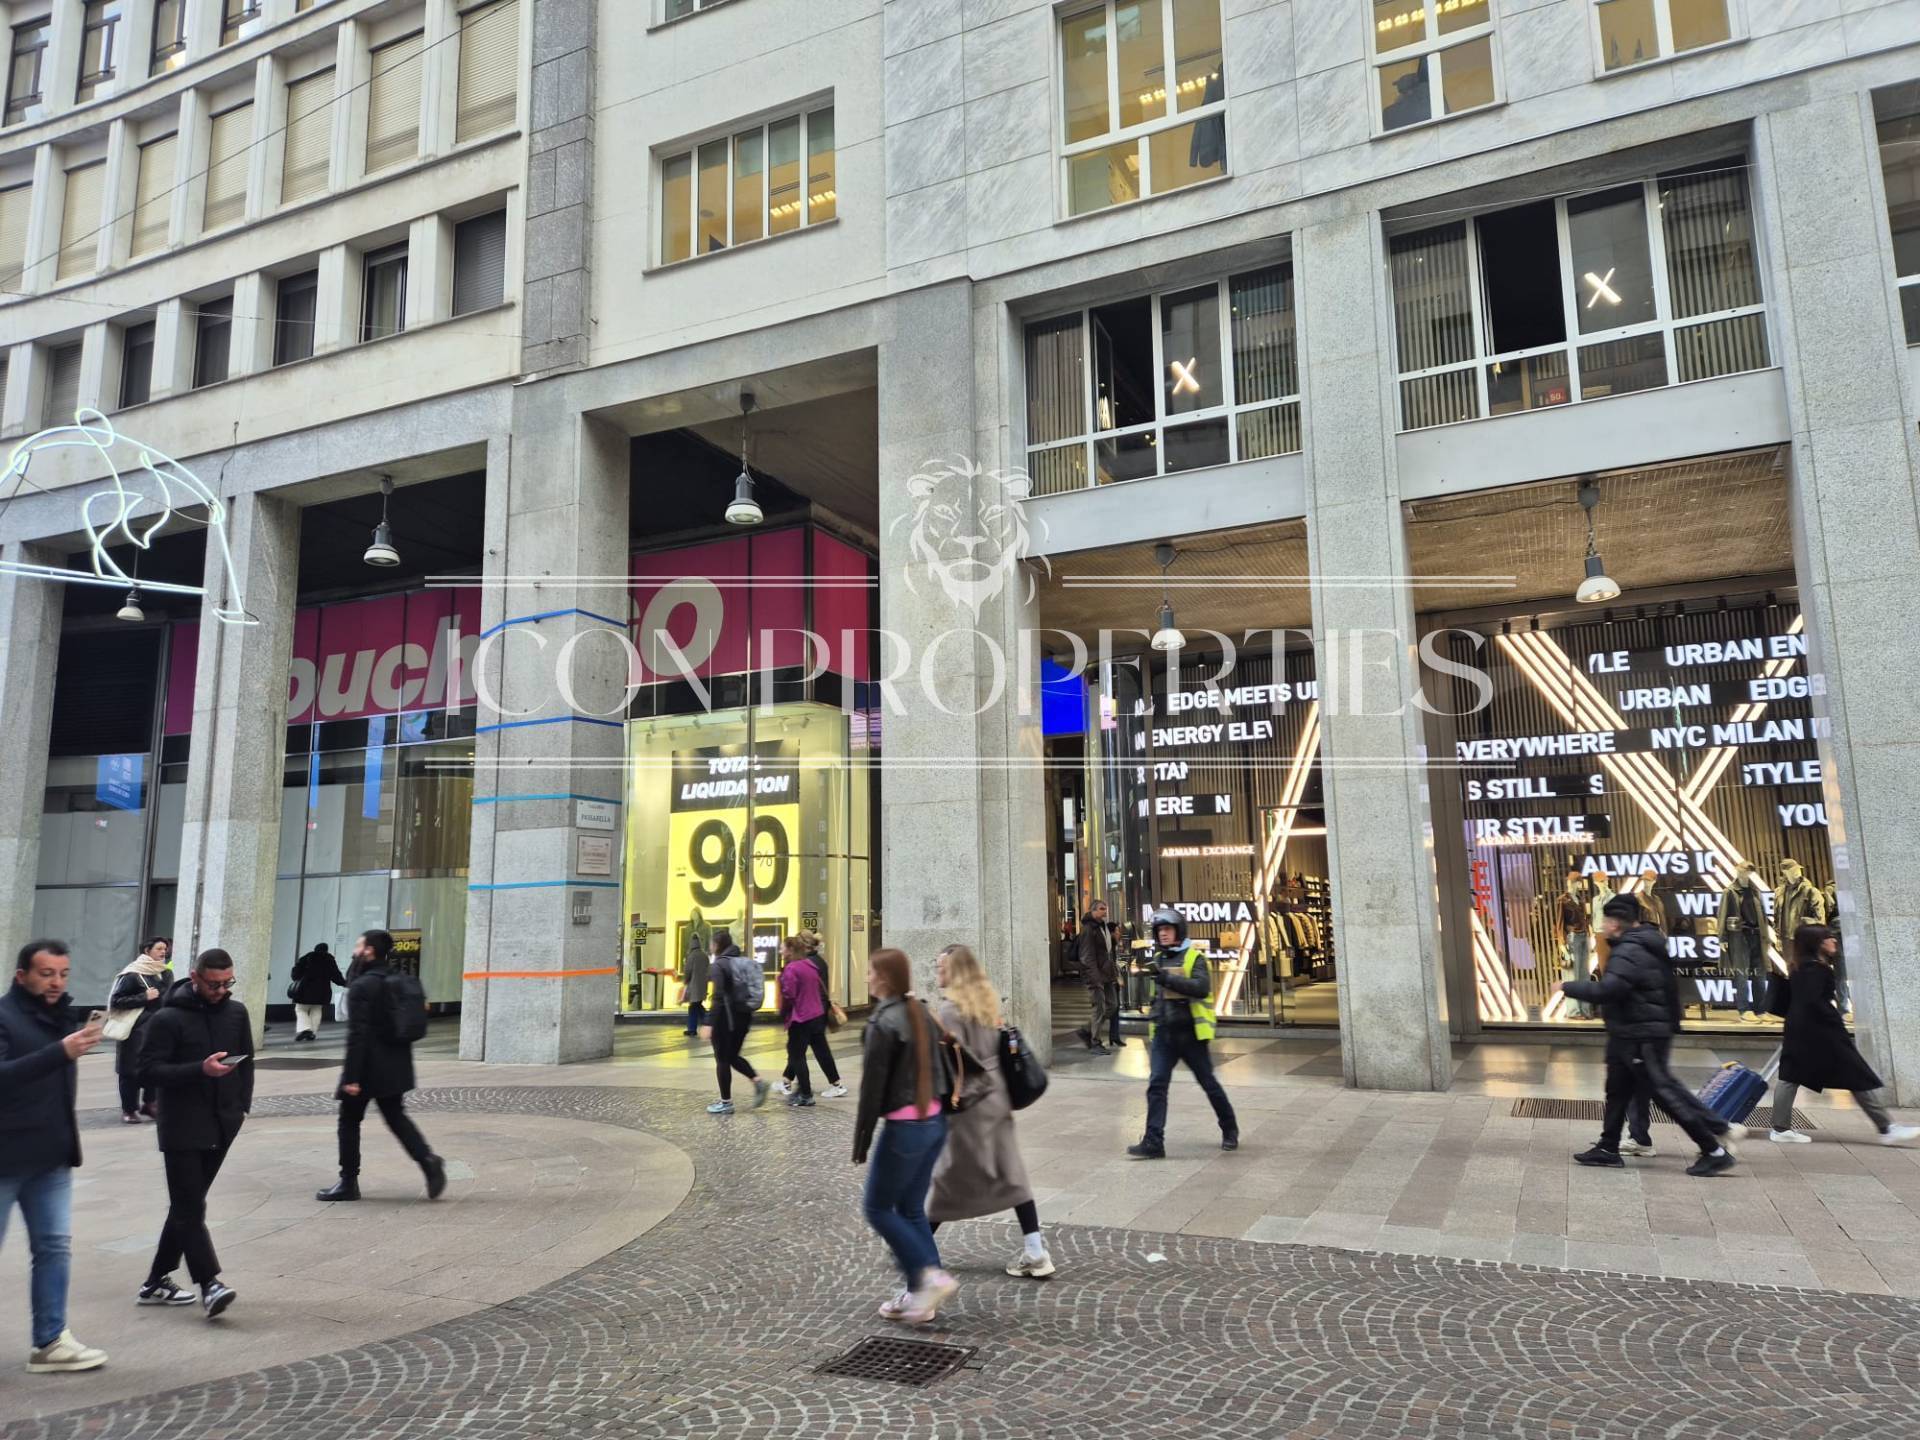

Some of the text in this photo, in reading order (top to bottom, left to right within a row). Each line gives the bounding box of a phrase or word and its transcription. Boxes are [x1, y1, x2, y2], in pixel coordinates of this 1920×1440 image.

[1665, 638, 1765, 667] URBAN
[1167, 688, 1222, 712] EDGE
[1224, 683, 1292, 706] MEETS
[1619, 683, 1712, 711] URBAN
[1152, 724, 1224, 747] ENERGY
[1652, 725, 1707, 749] NYC
[1712, 718, 1805, 745] MILAN
[1486, 776, 1557, 799] STILL
[1215, 794, 1232, 814] N
[689, 815, 789, 909] 90
[1203, 845, 1256, 857] EXCHANGE
[1580, 852, 1690, 878] ALWAYS
[803, 918, 818, 928] 90
[1179, 903, 1231, 923] FROM
[1236, 903, 1253, 922] A
